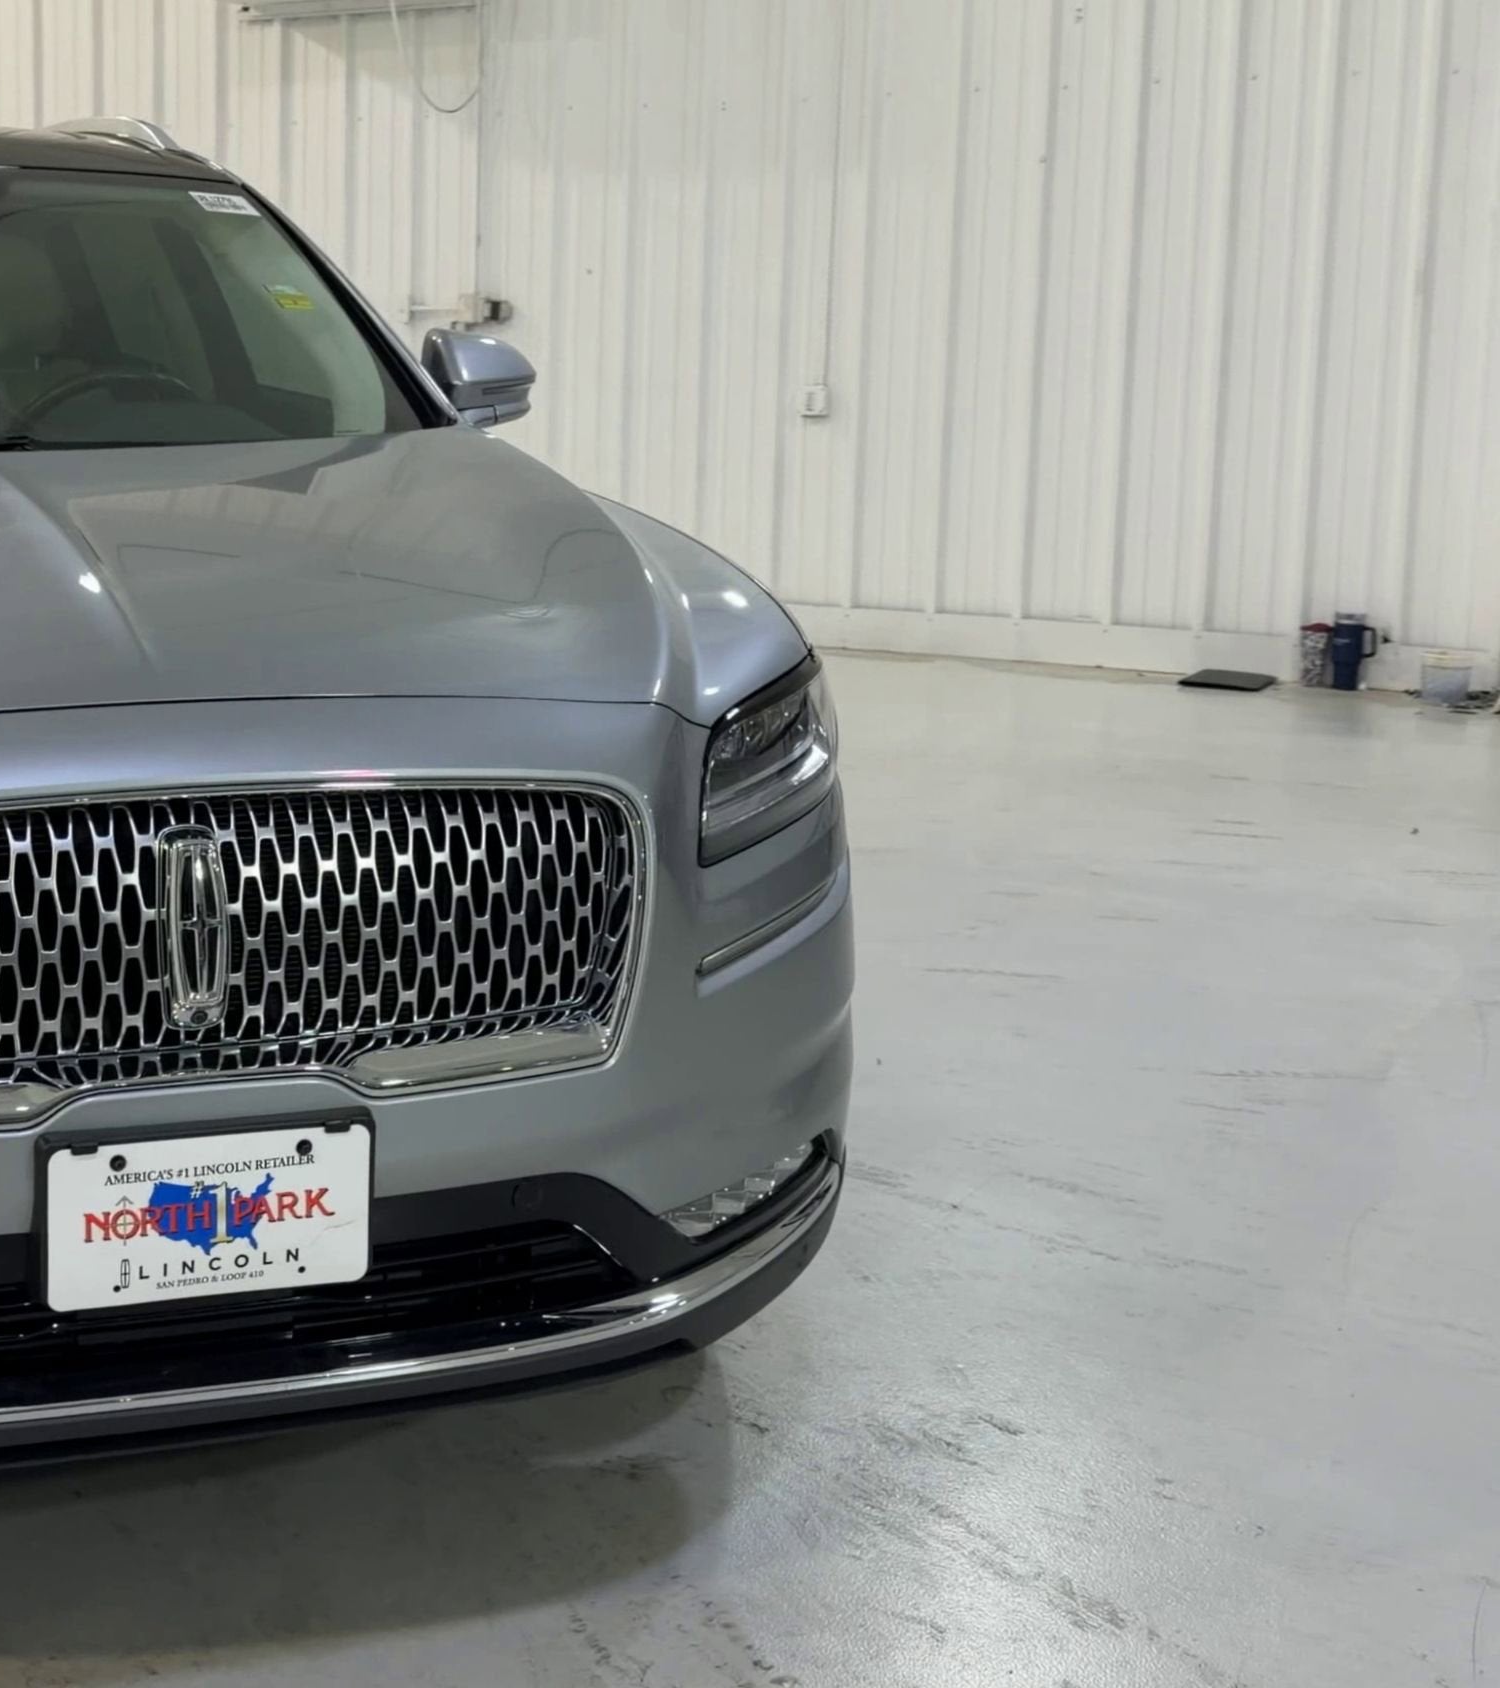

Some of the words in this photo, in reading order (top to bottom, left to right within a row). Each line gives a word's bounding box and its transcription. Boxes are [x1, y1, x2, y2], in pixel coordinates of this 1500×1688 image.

[104, 1169, 173, 1186] AMERICA'S
[176, 1168, 189, 1179] #1
[194, 1160, 252, 1177] LINCOLN
[255, 1154, 315, 1170] RETAILER
[83, 1202, 211, 1243] NORTH
[233, 1188, 335, 1227] PARK
[139, 1248, 299, 1280] LINCOLN
[156, 1281, 175, 1290] SAN
[177, 1276, 209, 1287] PEDRO
[211, 1275, 218, 1283] &
[220, 1272, 246, 1282] LOOP
[249, 1270, 264, 1279] 410
